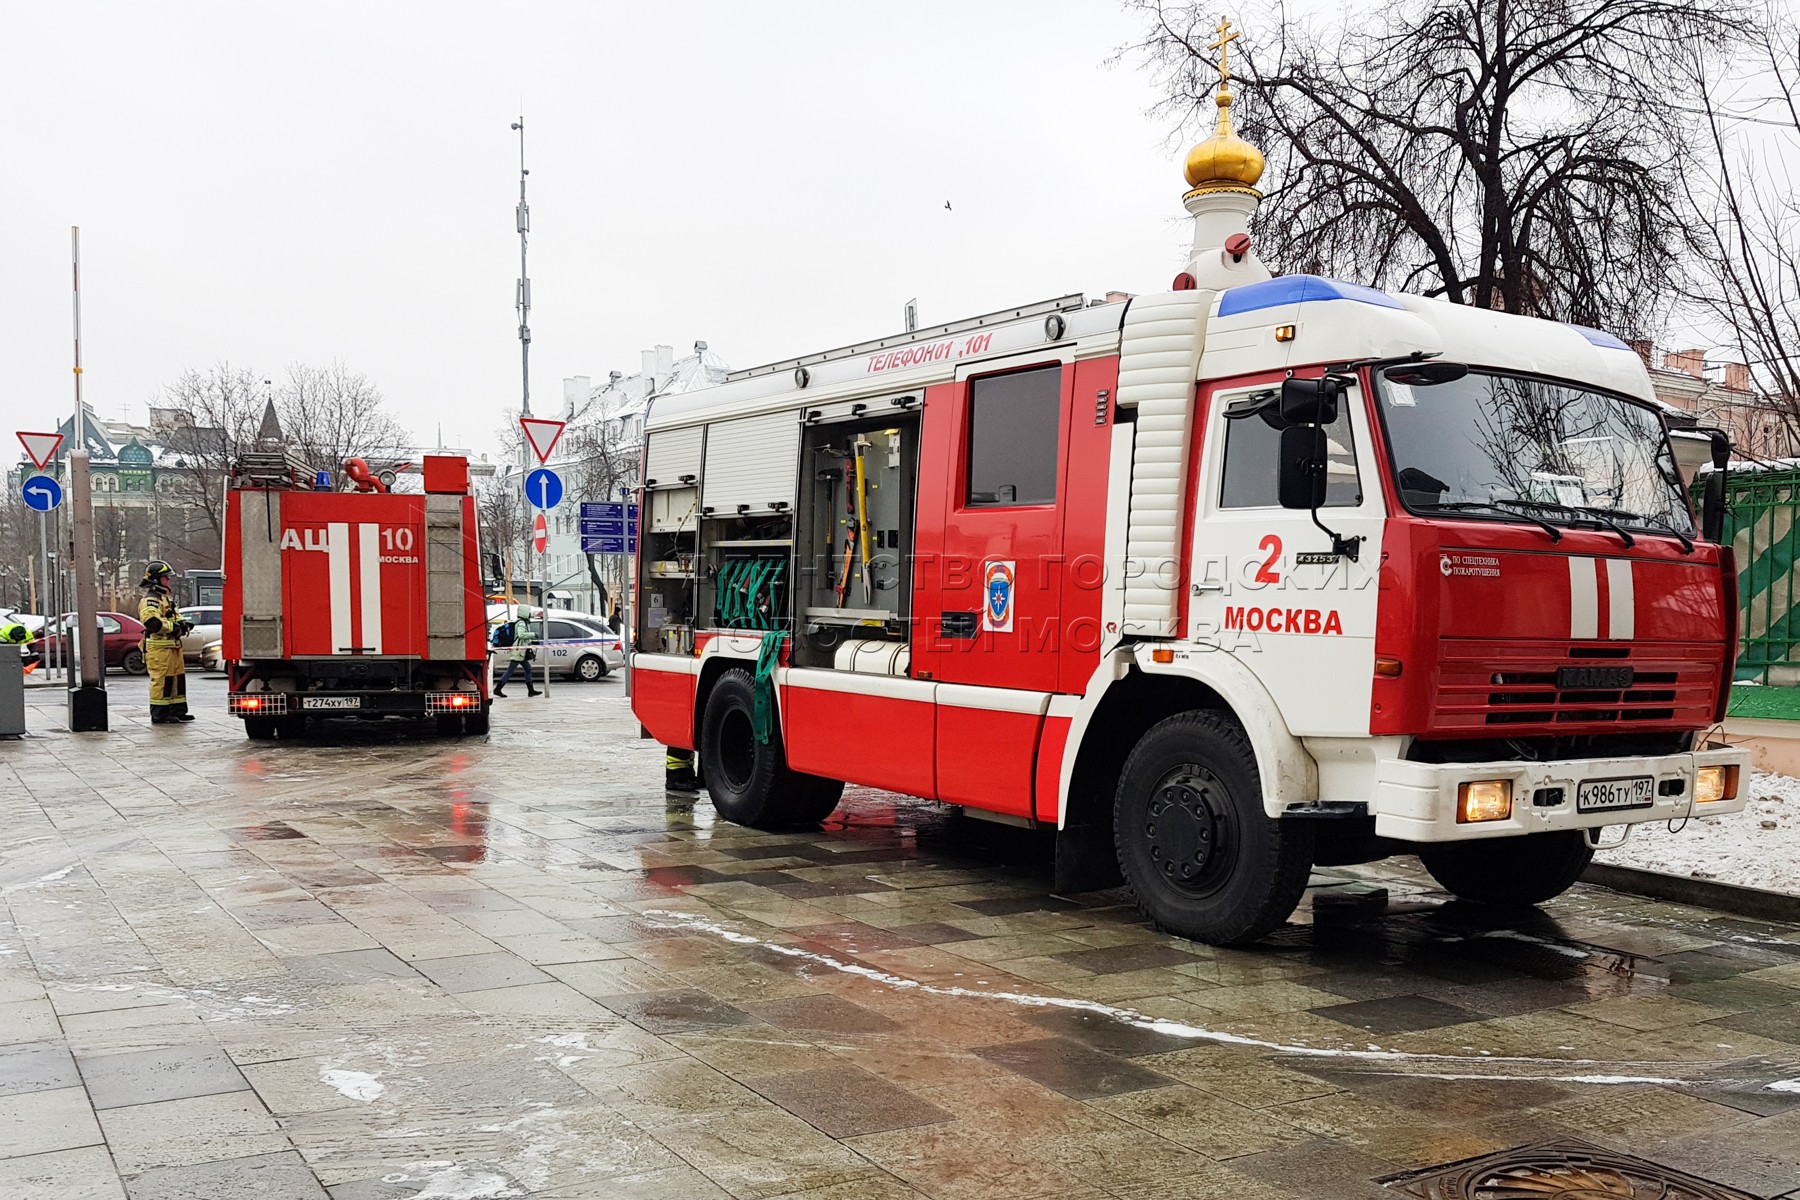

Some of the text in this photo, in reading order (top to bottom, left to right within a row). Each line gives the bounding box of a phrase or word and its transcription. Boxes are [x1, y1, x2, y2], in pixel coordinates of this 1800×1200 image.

[280, 528, 414, 553] АЦ 10
[377, 555, 419, 564] МОСКВА
[1254, 534, 1284, 583] 2
[1223, 606, 1344, 636] МОСКВА
[552, 649, 568, 657] 102
